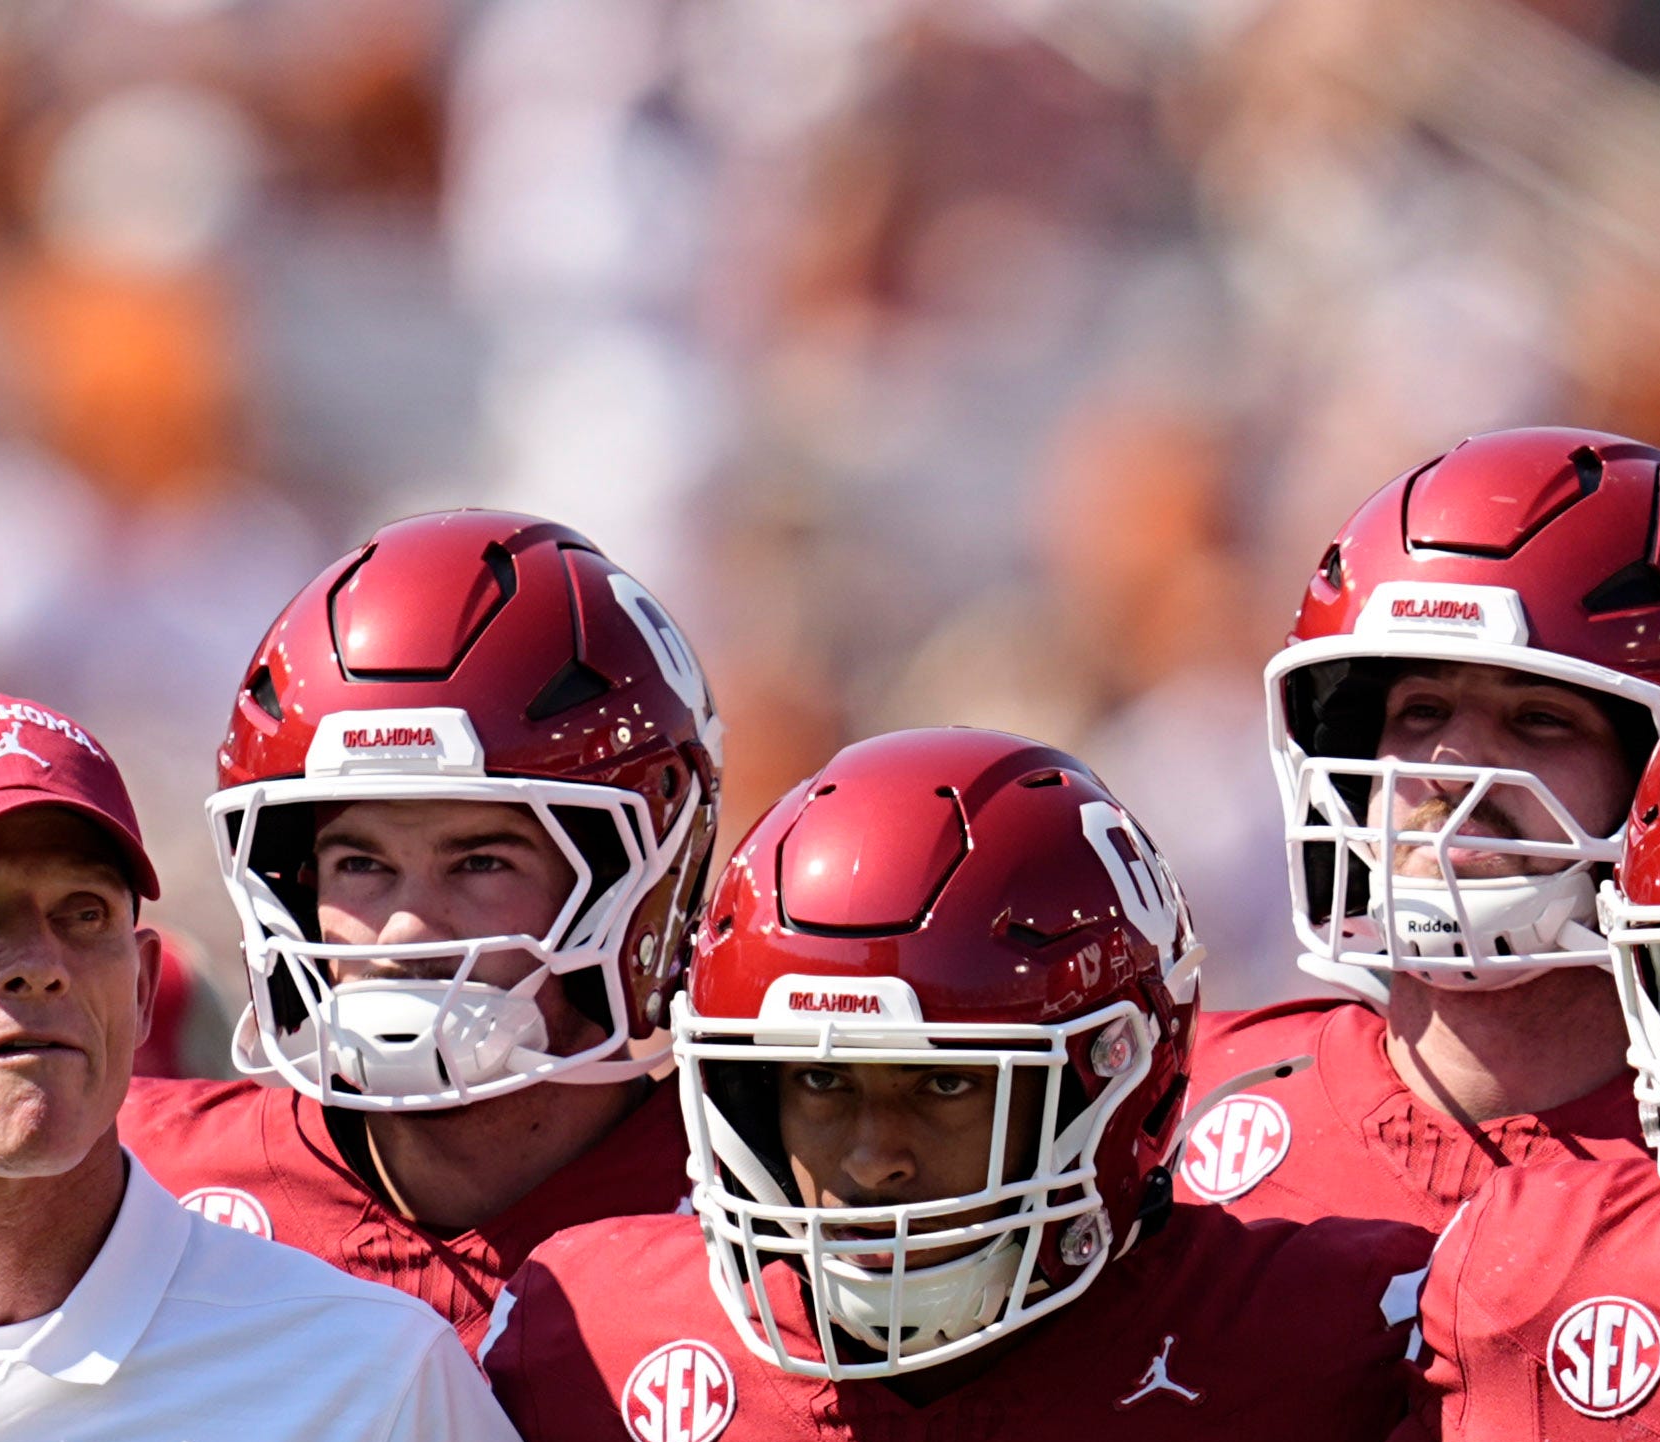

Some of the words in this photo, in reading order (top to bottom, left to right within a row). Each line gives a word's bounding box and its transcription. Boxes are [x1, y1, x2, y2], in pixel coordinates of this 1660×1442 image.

[1391, 599, 1481, 623] OKLAHOMA
[607, 573, 711, 738] O
[342, 728, 436, 749] OKLAHOMA
[789, 991, 881, 1014] OKLAHOMA
[1187, 1102, 1286, 1194] SEC
[1557, 1303, 1659, 1411] SEC
